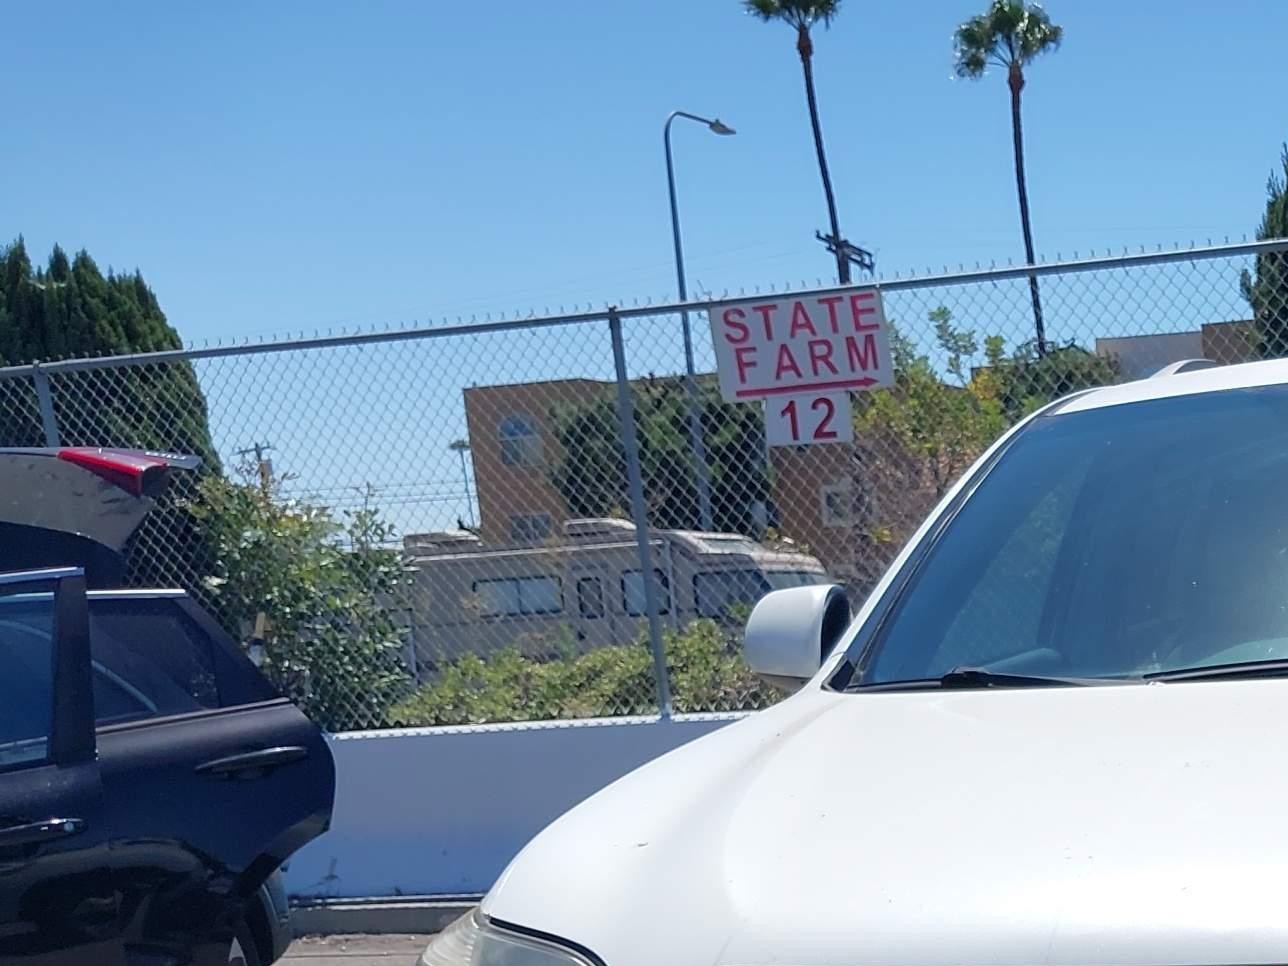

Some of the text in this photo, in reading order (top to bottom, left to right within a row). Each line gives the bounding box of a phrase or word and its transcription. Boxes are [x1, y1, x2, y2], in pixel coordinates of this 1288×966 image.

[722, 293, 880, 344] STATE
[734, 334, 879, 384] FARM
[780, 397, 837, 441] 12
